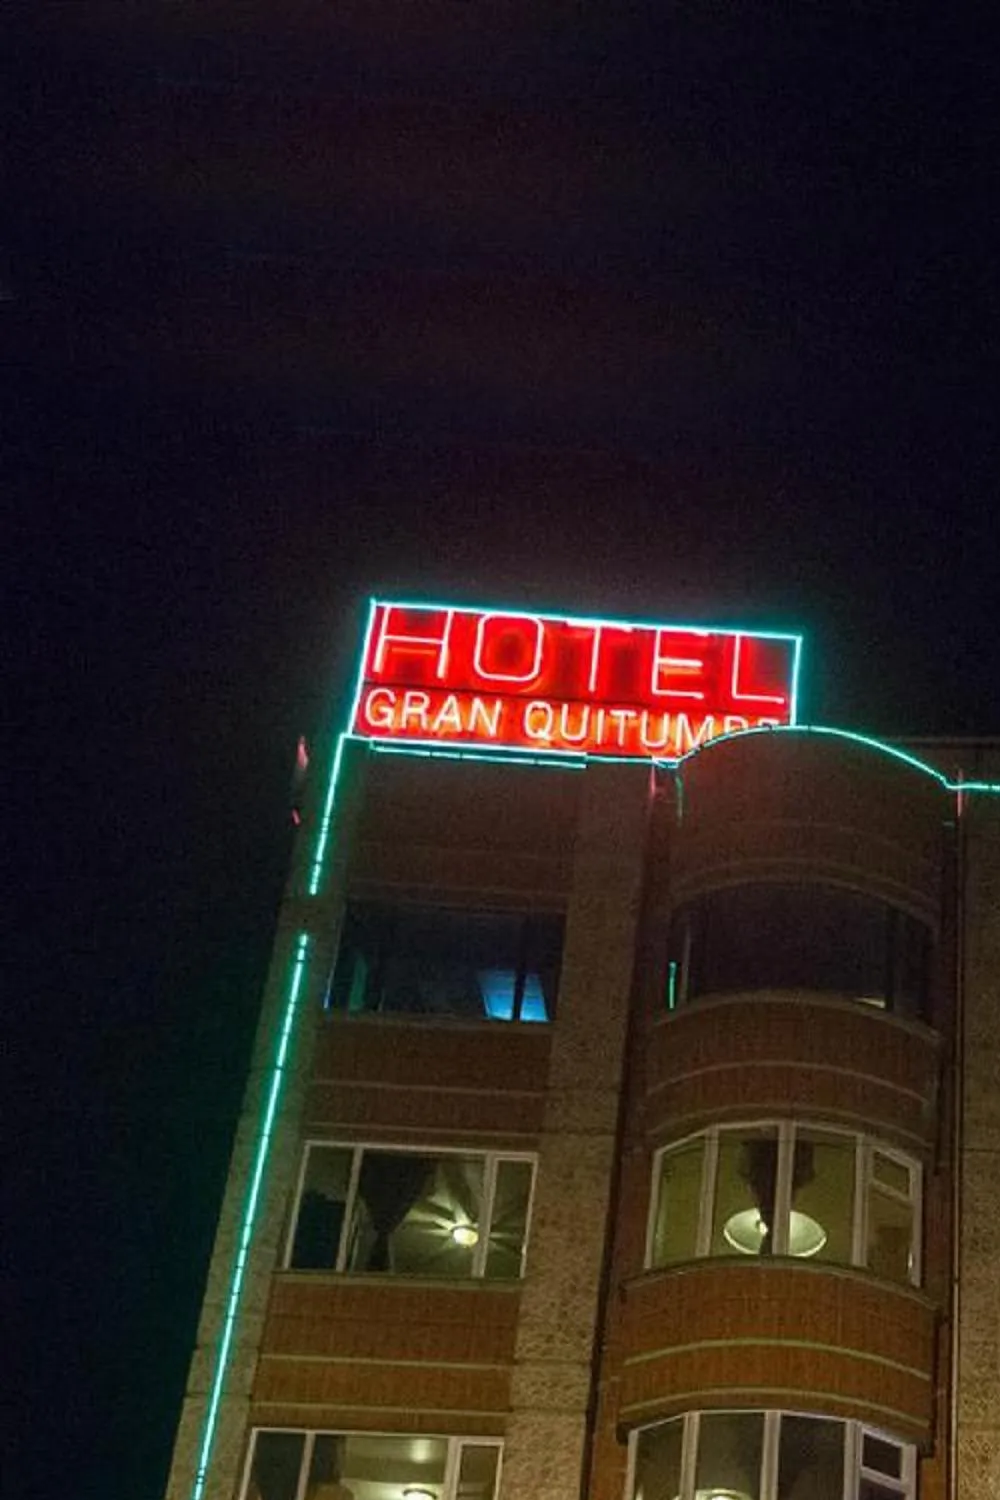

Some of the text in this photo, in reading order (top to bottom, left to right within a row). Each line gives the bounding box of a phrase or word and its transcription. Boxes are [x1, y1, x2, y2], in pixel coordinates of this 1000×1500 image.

[373, 605, 785, 704] HOTEL
[364, 687, 781, 750] GRAN QUITUM
